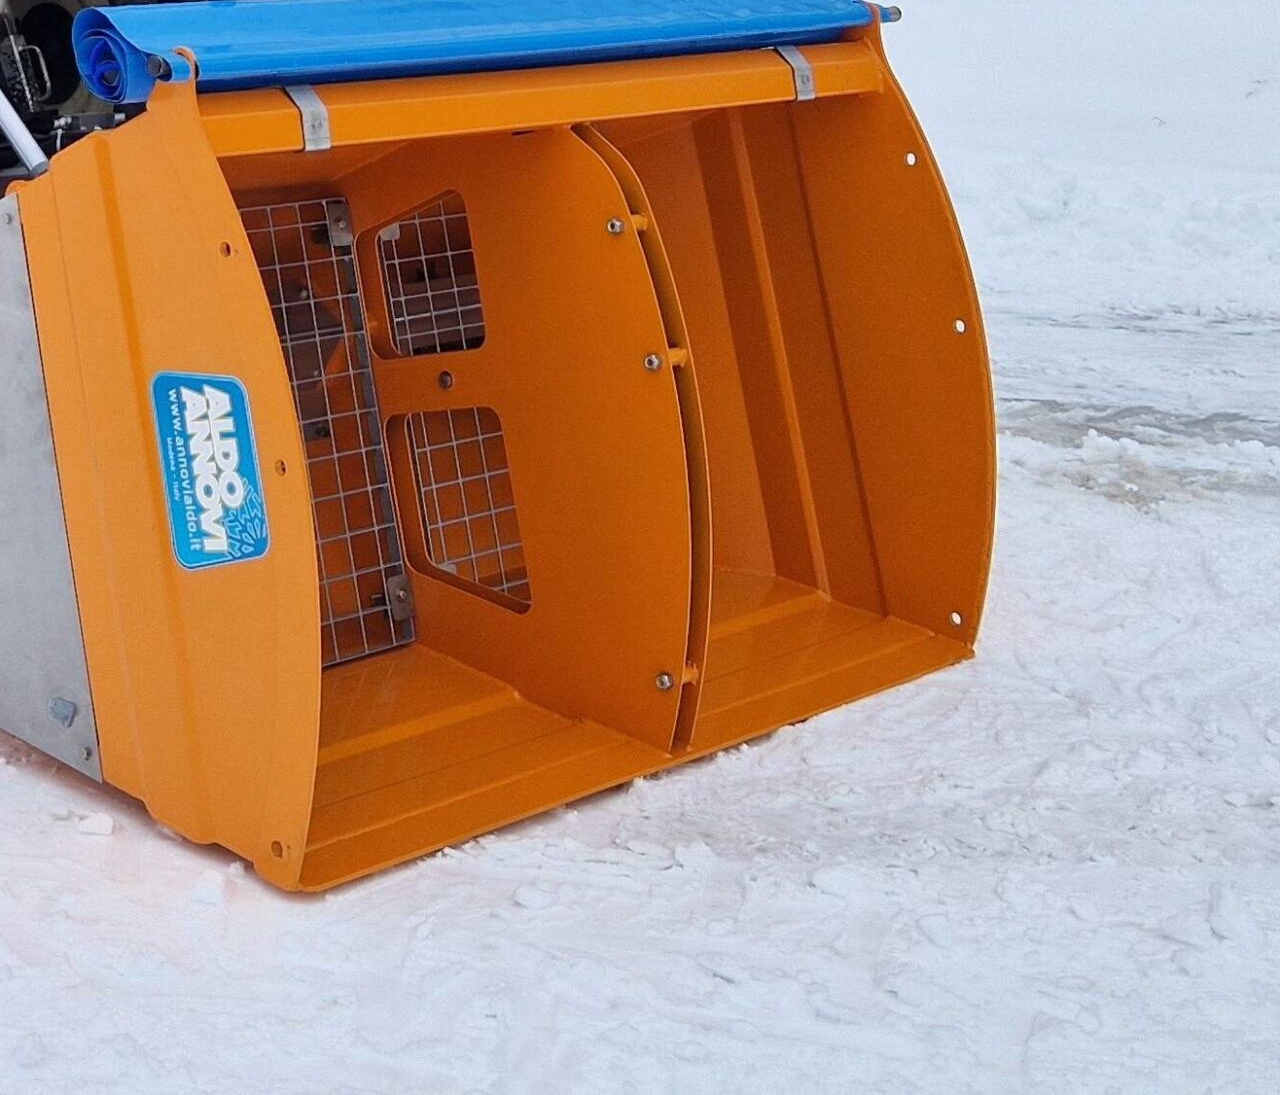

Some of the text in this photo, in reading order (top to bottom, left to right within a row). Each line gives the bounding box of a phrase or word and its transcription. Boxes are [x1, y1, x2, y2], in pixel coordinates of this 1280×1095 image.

[168, 388, 202, 551] www.annovialdo.it
[179, 386, 229, 553] ANNOVI
[202, 384, 244, 508] ALDO
